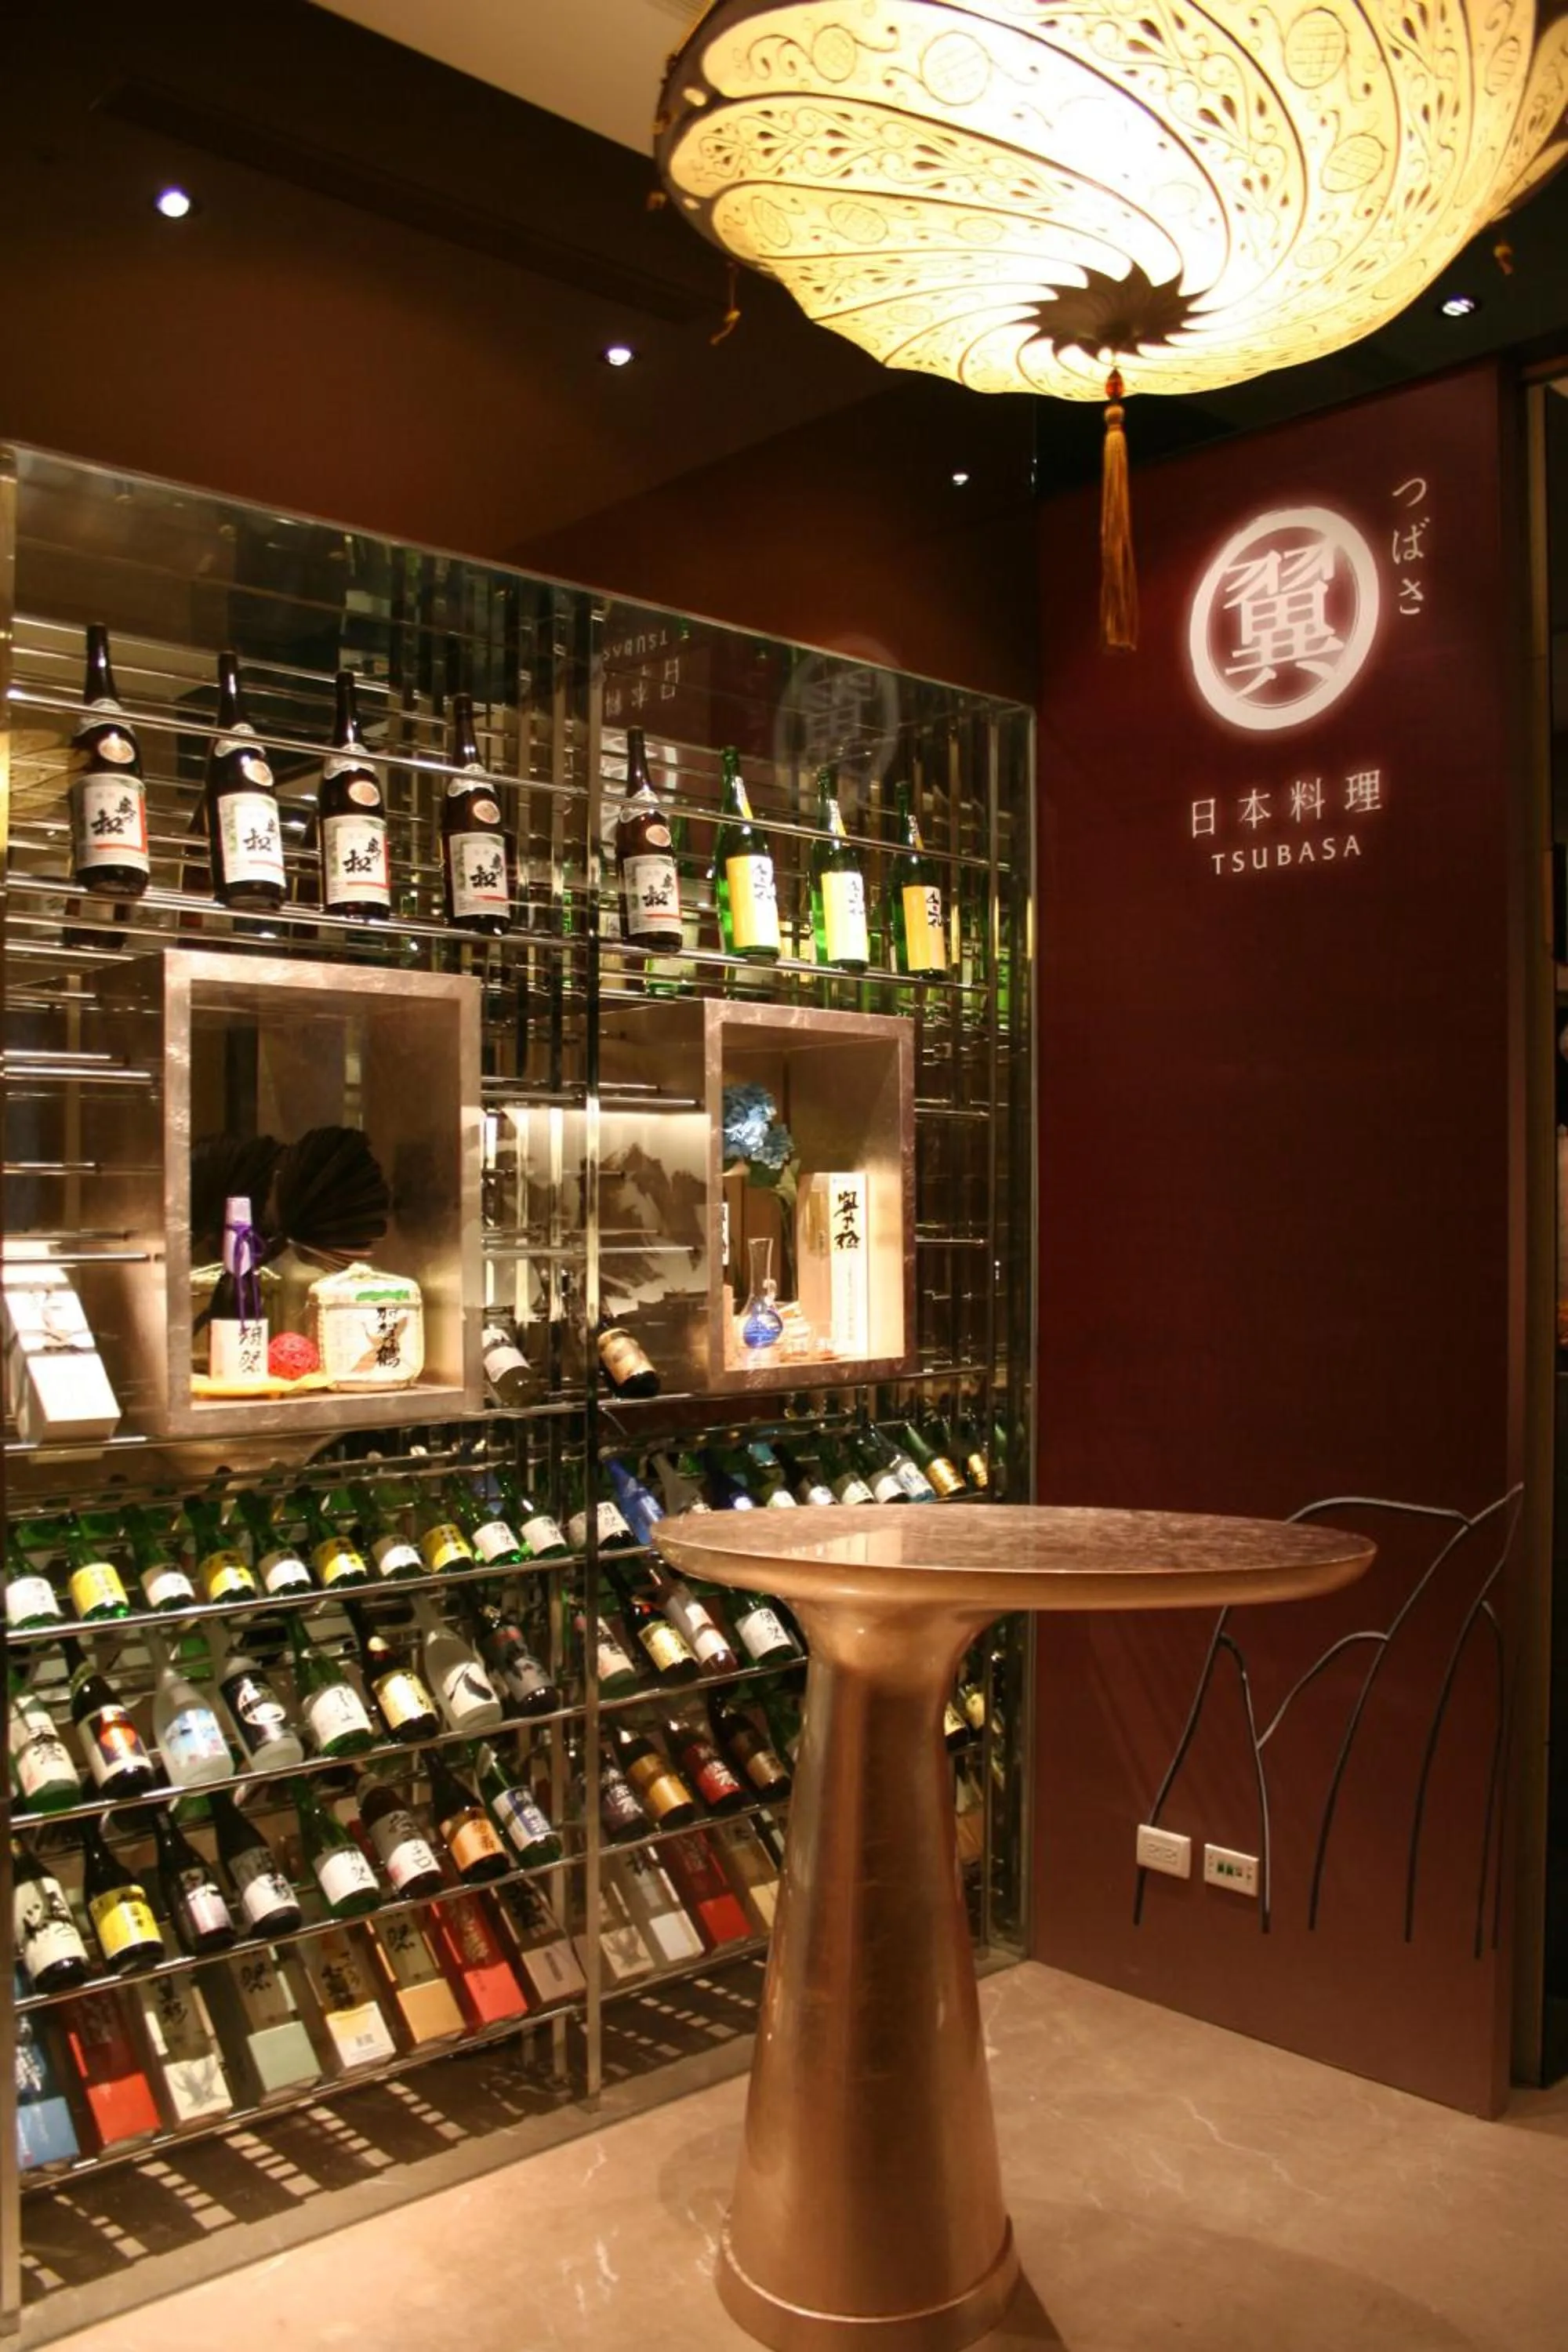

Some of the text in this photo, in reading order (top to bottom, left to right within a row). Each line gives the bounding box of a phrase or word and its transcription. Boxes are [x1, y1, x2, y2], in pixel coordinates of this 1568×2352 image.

[1392, 477, 1431, 615] つばさ
[1223, 541, 1345, 699] 翼
[1191, 769, 1383, 837] 日本料理
[1211, 835, 1361, 874] TSUBASA
